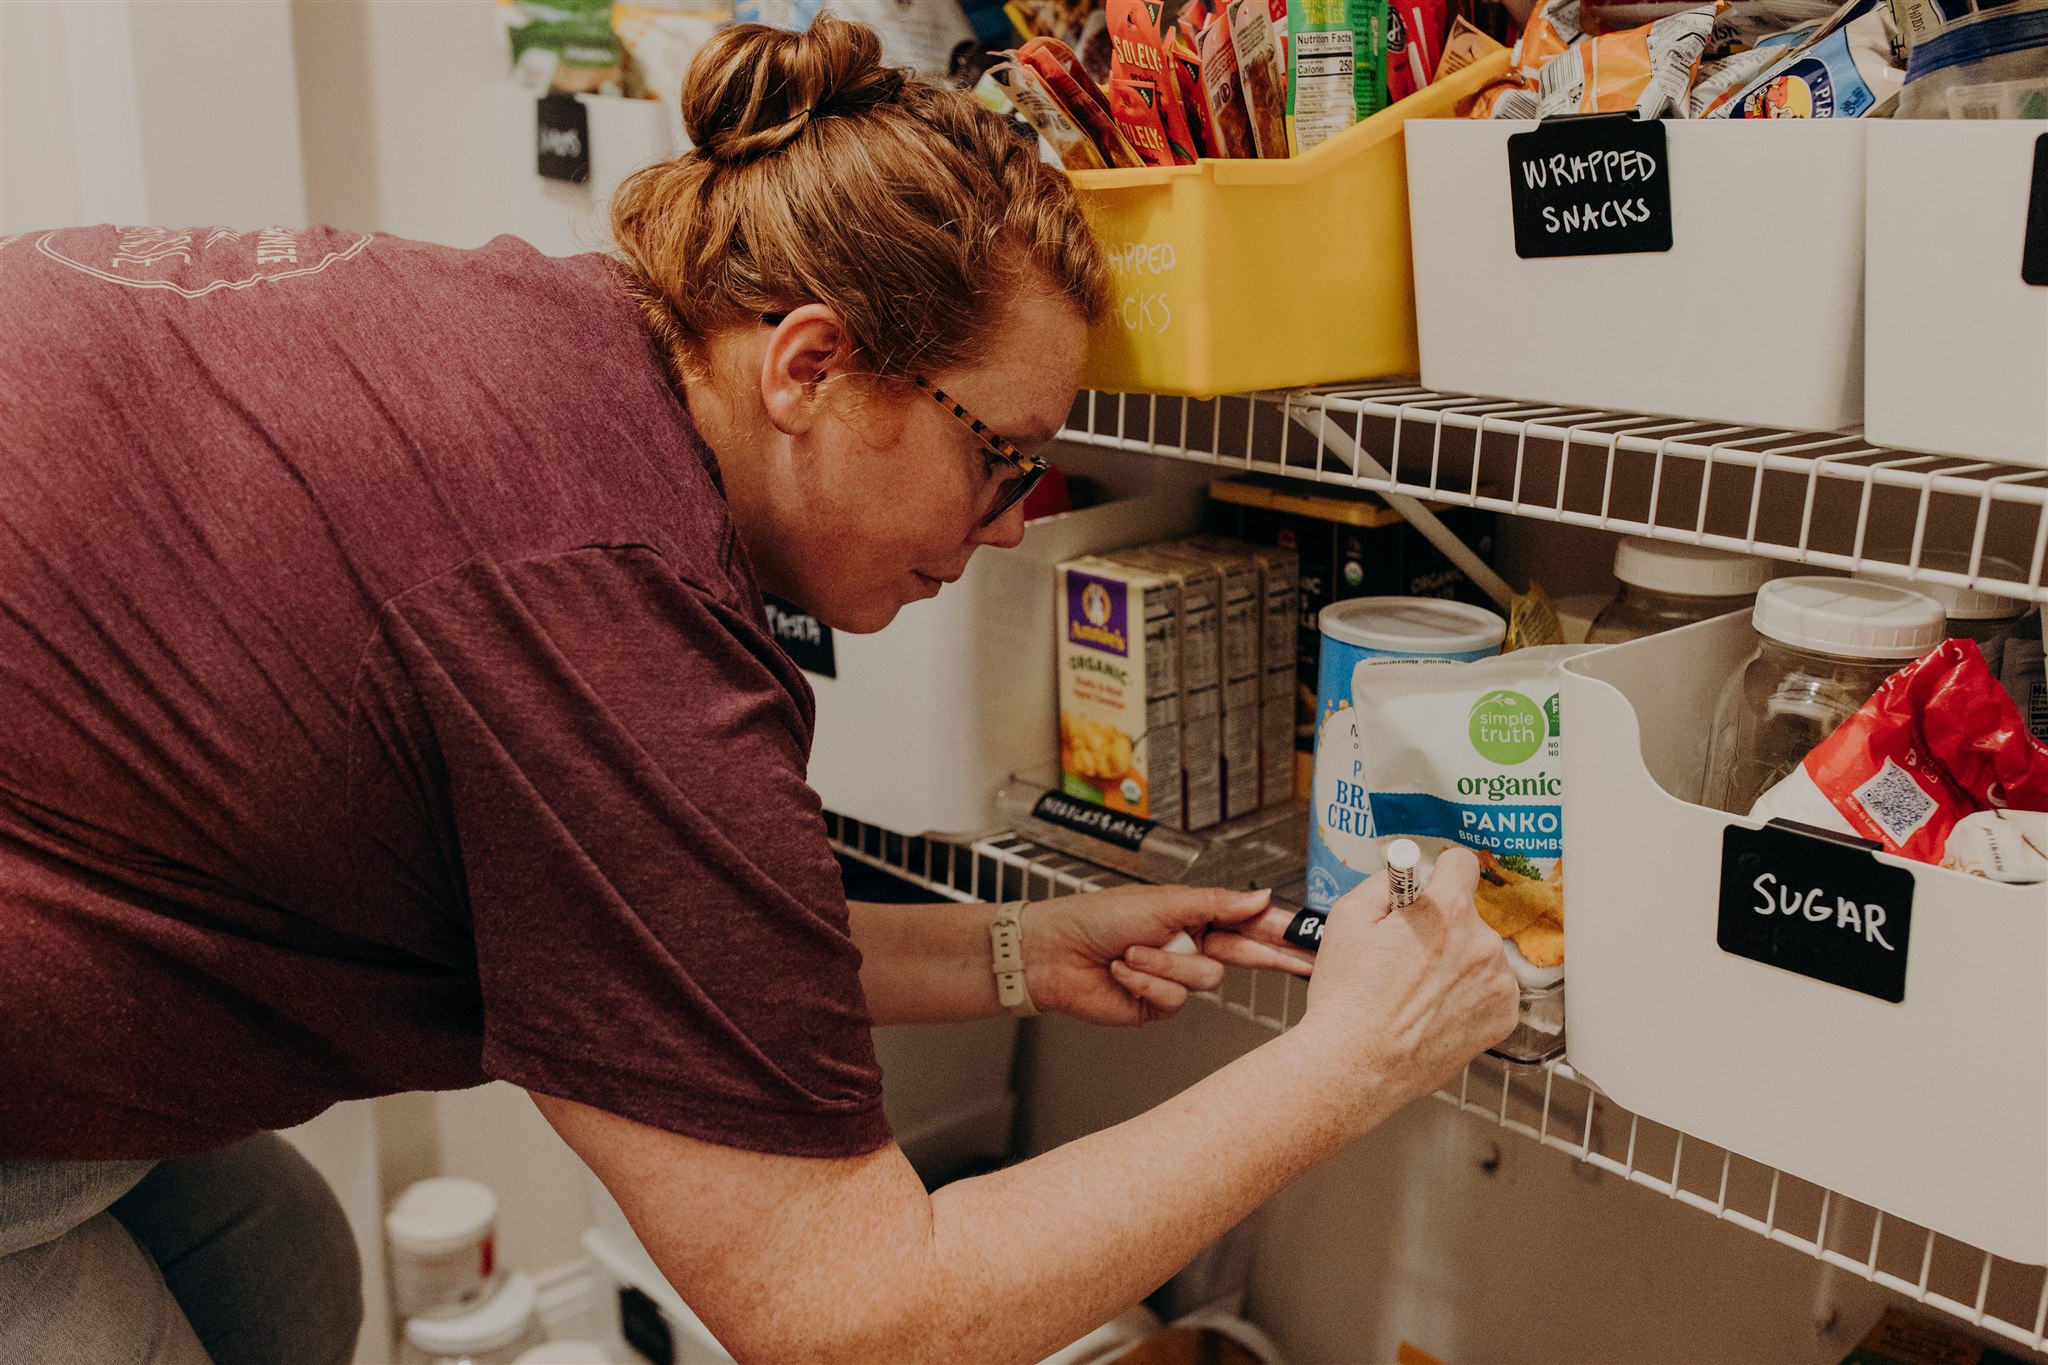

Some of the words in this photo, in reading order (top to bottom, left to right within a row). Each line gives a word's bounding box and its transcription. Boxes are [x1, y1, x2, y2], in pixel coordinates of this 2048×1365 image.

[1297, 35, 1329, 45] Nutrition
[1331, 33, 1352, 43] Facts
[1297, 65, 1325, 74] Calories
[1339, 60, 1353, 71] 250
[1814, 87, 1833, 118] PIR
[1522, 150, 1657, 189] WRAPPED
[1542, 197, 1651, 234] SNACKS
[1107, 242, 1177, 276] APPED
[1123, 293, 1171, 335] CKS
[1069, 656, 1128, 686] ORGANIC
[1479, 711, 1534, 728] simple
[1480, 726, 1535, 743] truth
[1457, 771, 1561, 801] organic
[1462, 810, 1558, 833] PANKO
[1458, 829, 1500, 848] BREAD
[1752, 872, 1895, 951] SUGAR
